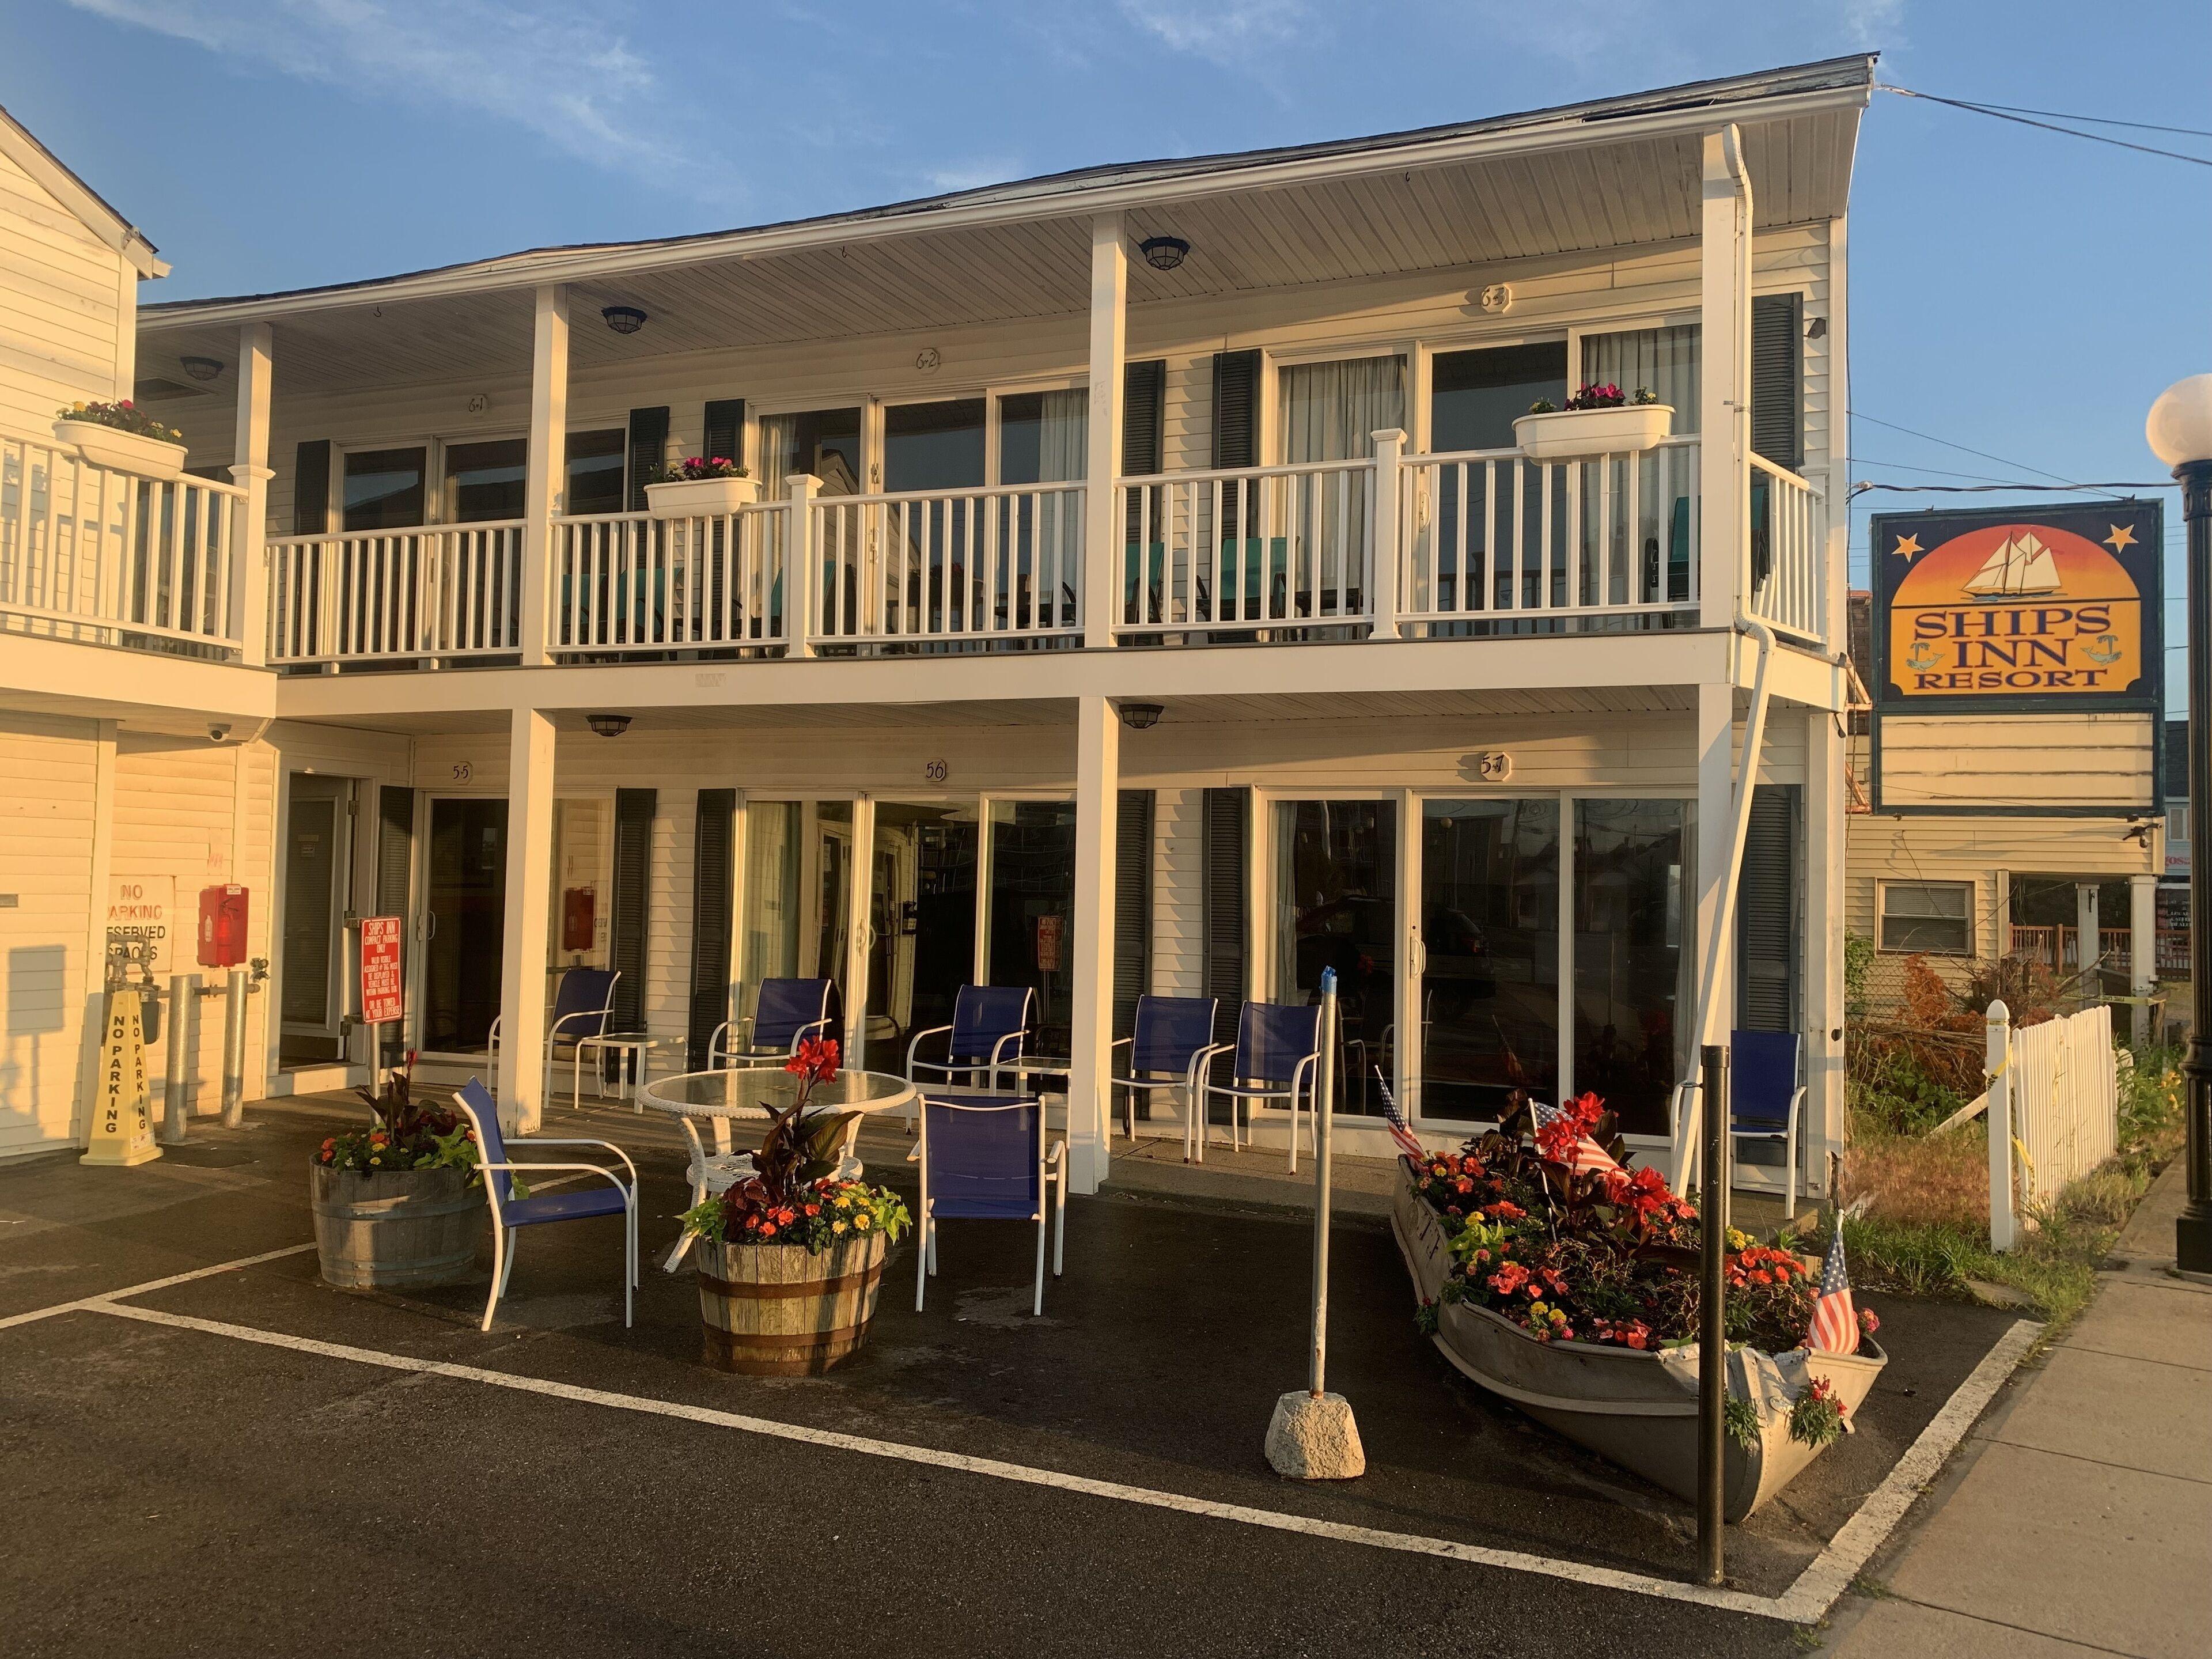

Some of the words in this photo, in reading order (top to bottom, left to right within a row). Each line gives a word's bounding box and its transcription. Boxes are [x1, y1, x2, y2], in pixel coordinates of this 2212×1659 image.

[1914, 604, 2111, 641] SHIPS
[1952, 638, 2074, 669] INN
[1914, 669, 2108, 690] RESORT
[453, 765, 468, 779] 55
[926, 762, 944, 778] 56
[120, 885, 143, 900] NO
[108, 905, 162, 921] ARKING
[107, 926, 165, 939] ESERVED
[368, 922, 384, 935] SHIPS
[387, 921, 395, 934] INN
[382, 934, 397, 944] PARKING
[376, 944, 385, 953] ONLY
[372, 1008, 382, 1018] YOUR
[384, 1005, 400, 1016] EXPENSE
[112, 1016, 124, 1039] NO
[132, 1014, 139, 1037] NO
[105, 1046, 122, 1133] PARKING
[135, 1044, 145, 1130] PARKING
